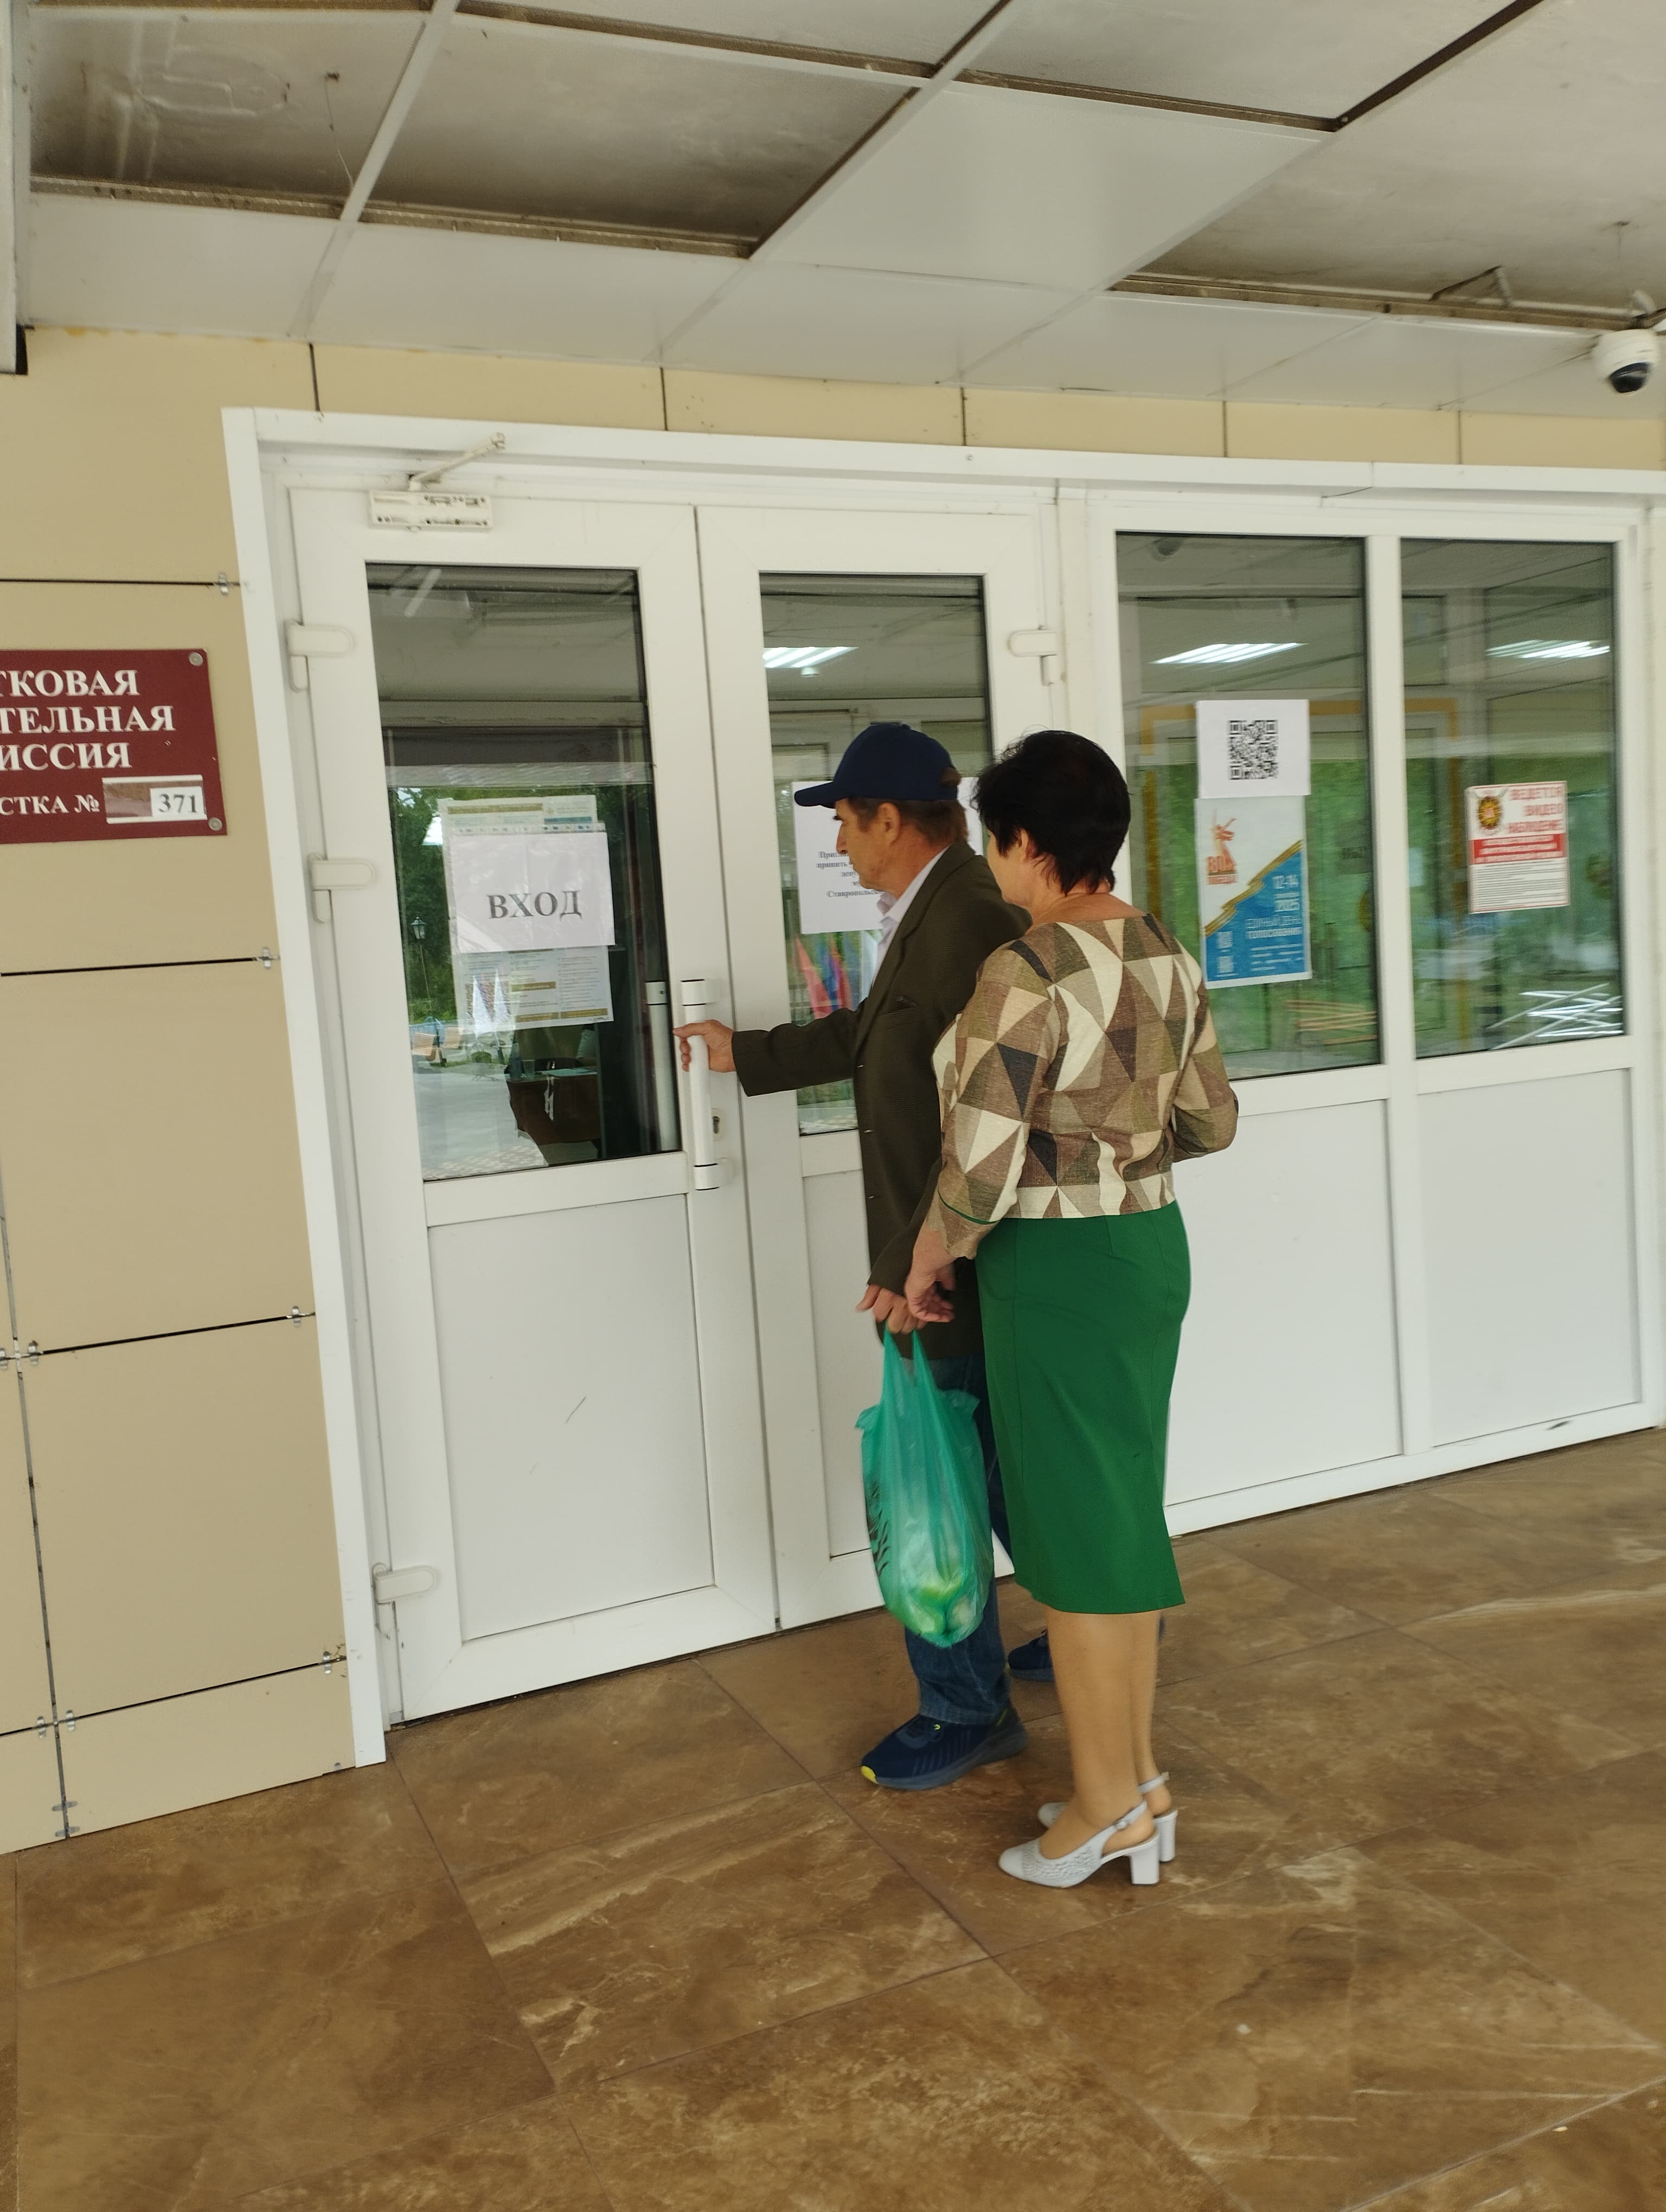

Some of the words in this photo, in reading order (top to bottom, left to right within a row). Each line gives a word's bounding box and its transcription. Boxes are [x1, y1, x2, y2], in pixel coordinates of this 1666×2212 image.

[0, 705, 176, 734] ТЕЛЬНАЯ
[0, 795, 69, 815] СТКА
[74, 794, 100, 812] №
[158, 793, 197, 813] 371
[486, 890, 582, 922] ВХОД
